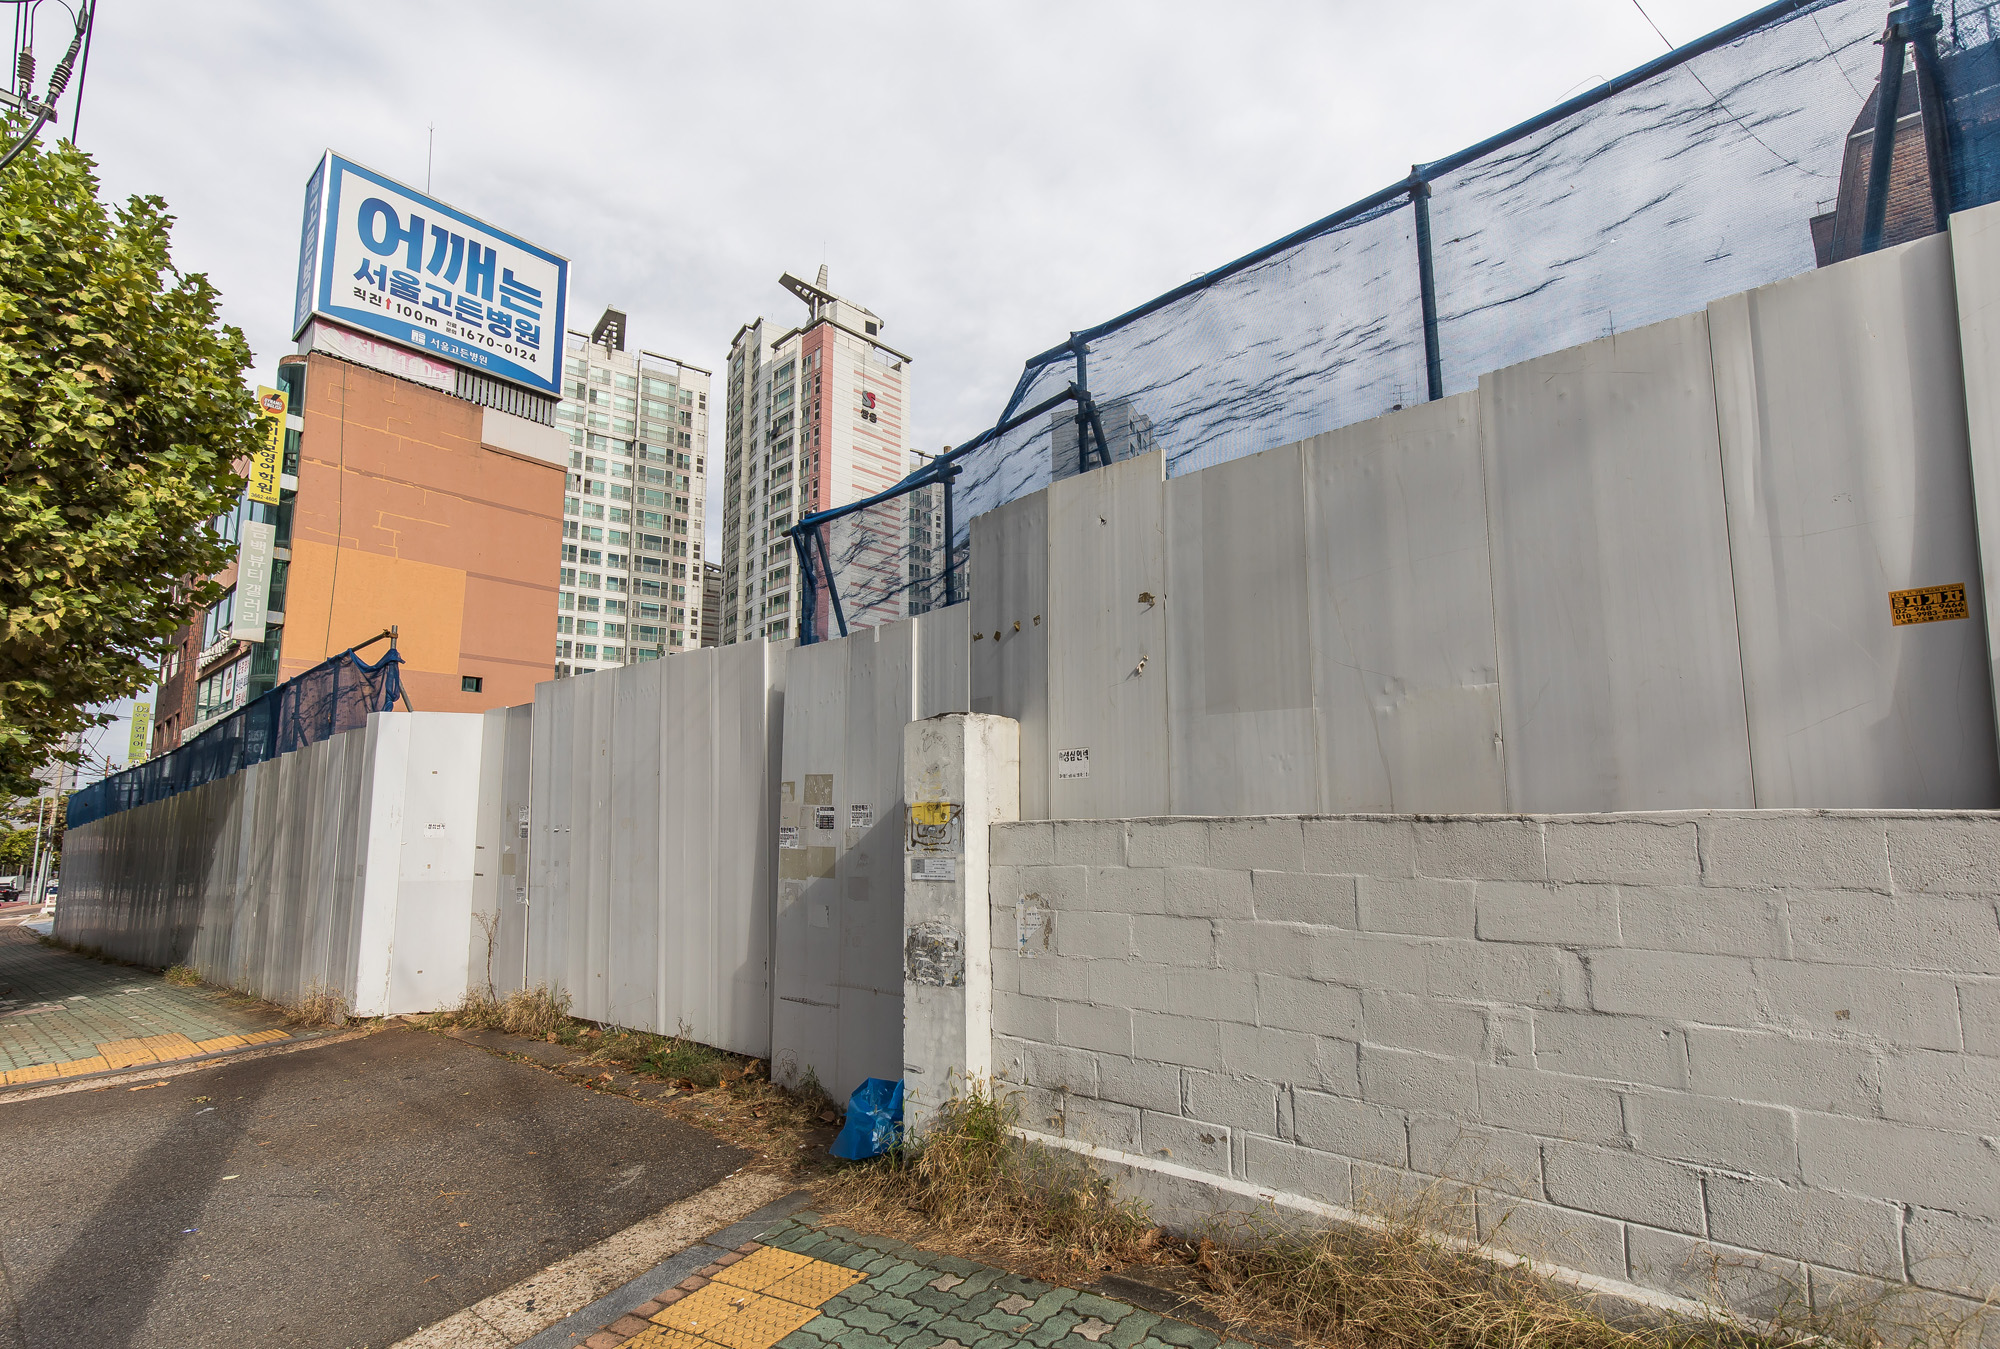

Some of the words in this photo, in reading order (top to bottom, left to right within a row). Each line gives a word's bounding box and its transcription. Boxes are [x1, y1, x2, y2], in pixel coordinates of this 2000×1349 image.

[357, 197, 543, 321] 어깨는
[353, 257, 541, 350] 서울고든병원
[353, 286, 382, 307] 직진
[396, 303, 438, 327] 100m
[430, 337, 488, 366] 서울고든병원
[460, 326, 537, 363] 1670-0124
